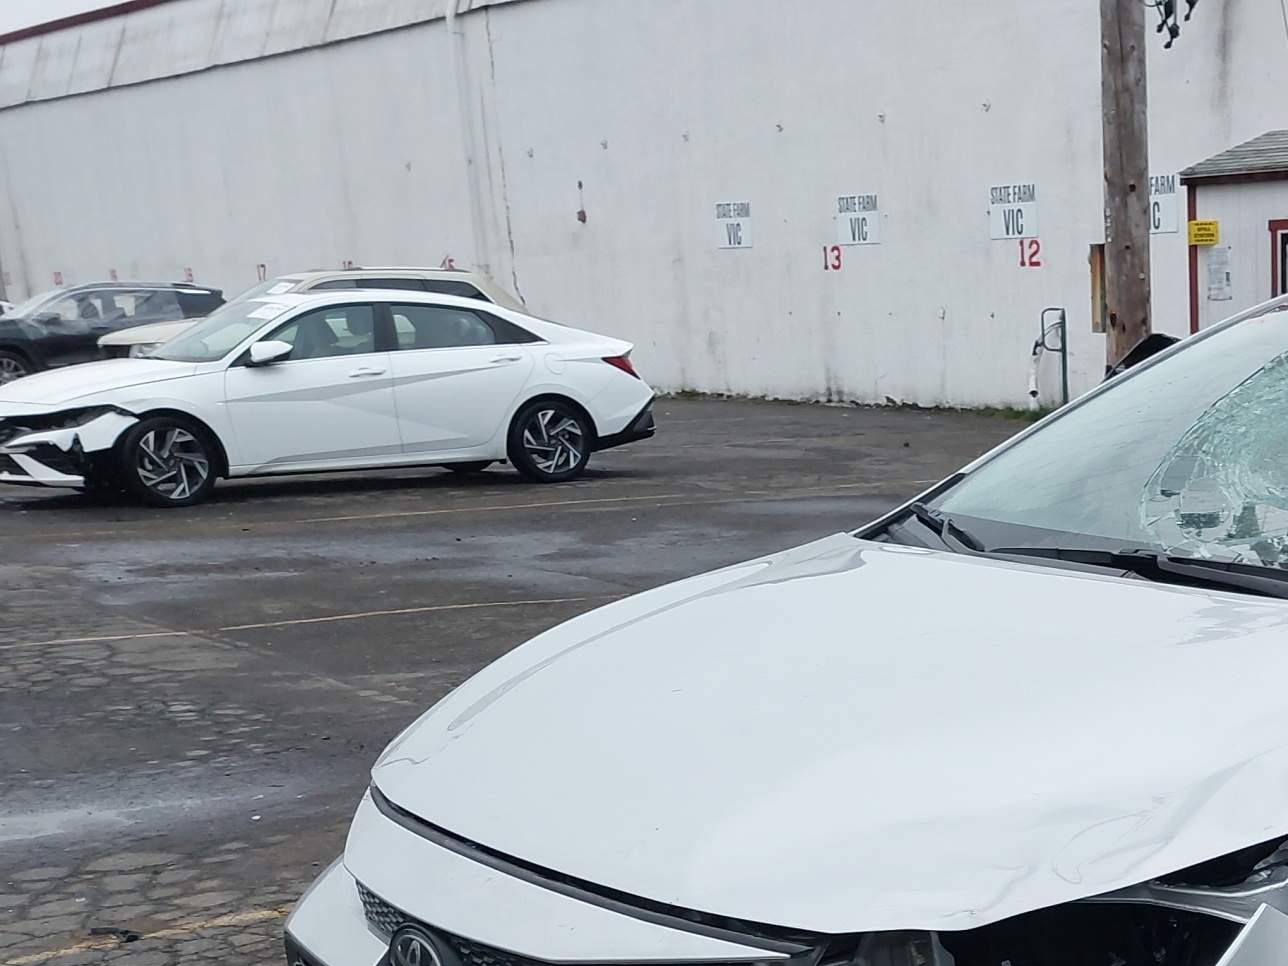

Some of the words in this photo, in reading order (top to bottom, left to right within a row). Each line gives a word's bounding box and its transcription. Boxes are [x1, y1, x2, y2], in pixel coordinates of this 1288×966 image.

[990, 185, 1011, 204] STATE
[1013, 184, 1036, 203] FARM
[1149, 174, 1176, 195] FARM
[838, 196, 856, 213] STATE
[858, 194, 878, 212] FARM
[849, 217, 868, 241] VIC
[1003, 208, 1024, 236] VIC
[726, 223, 742, 246] VIC
[823, 246, 842, 270] 13
[1019, 239, 1041, 267] 12
